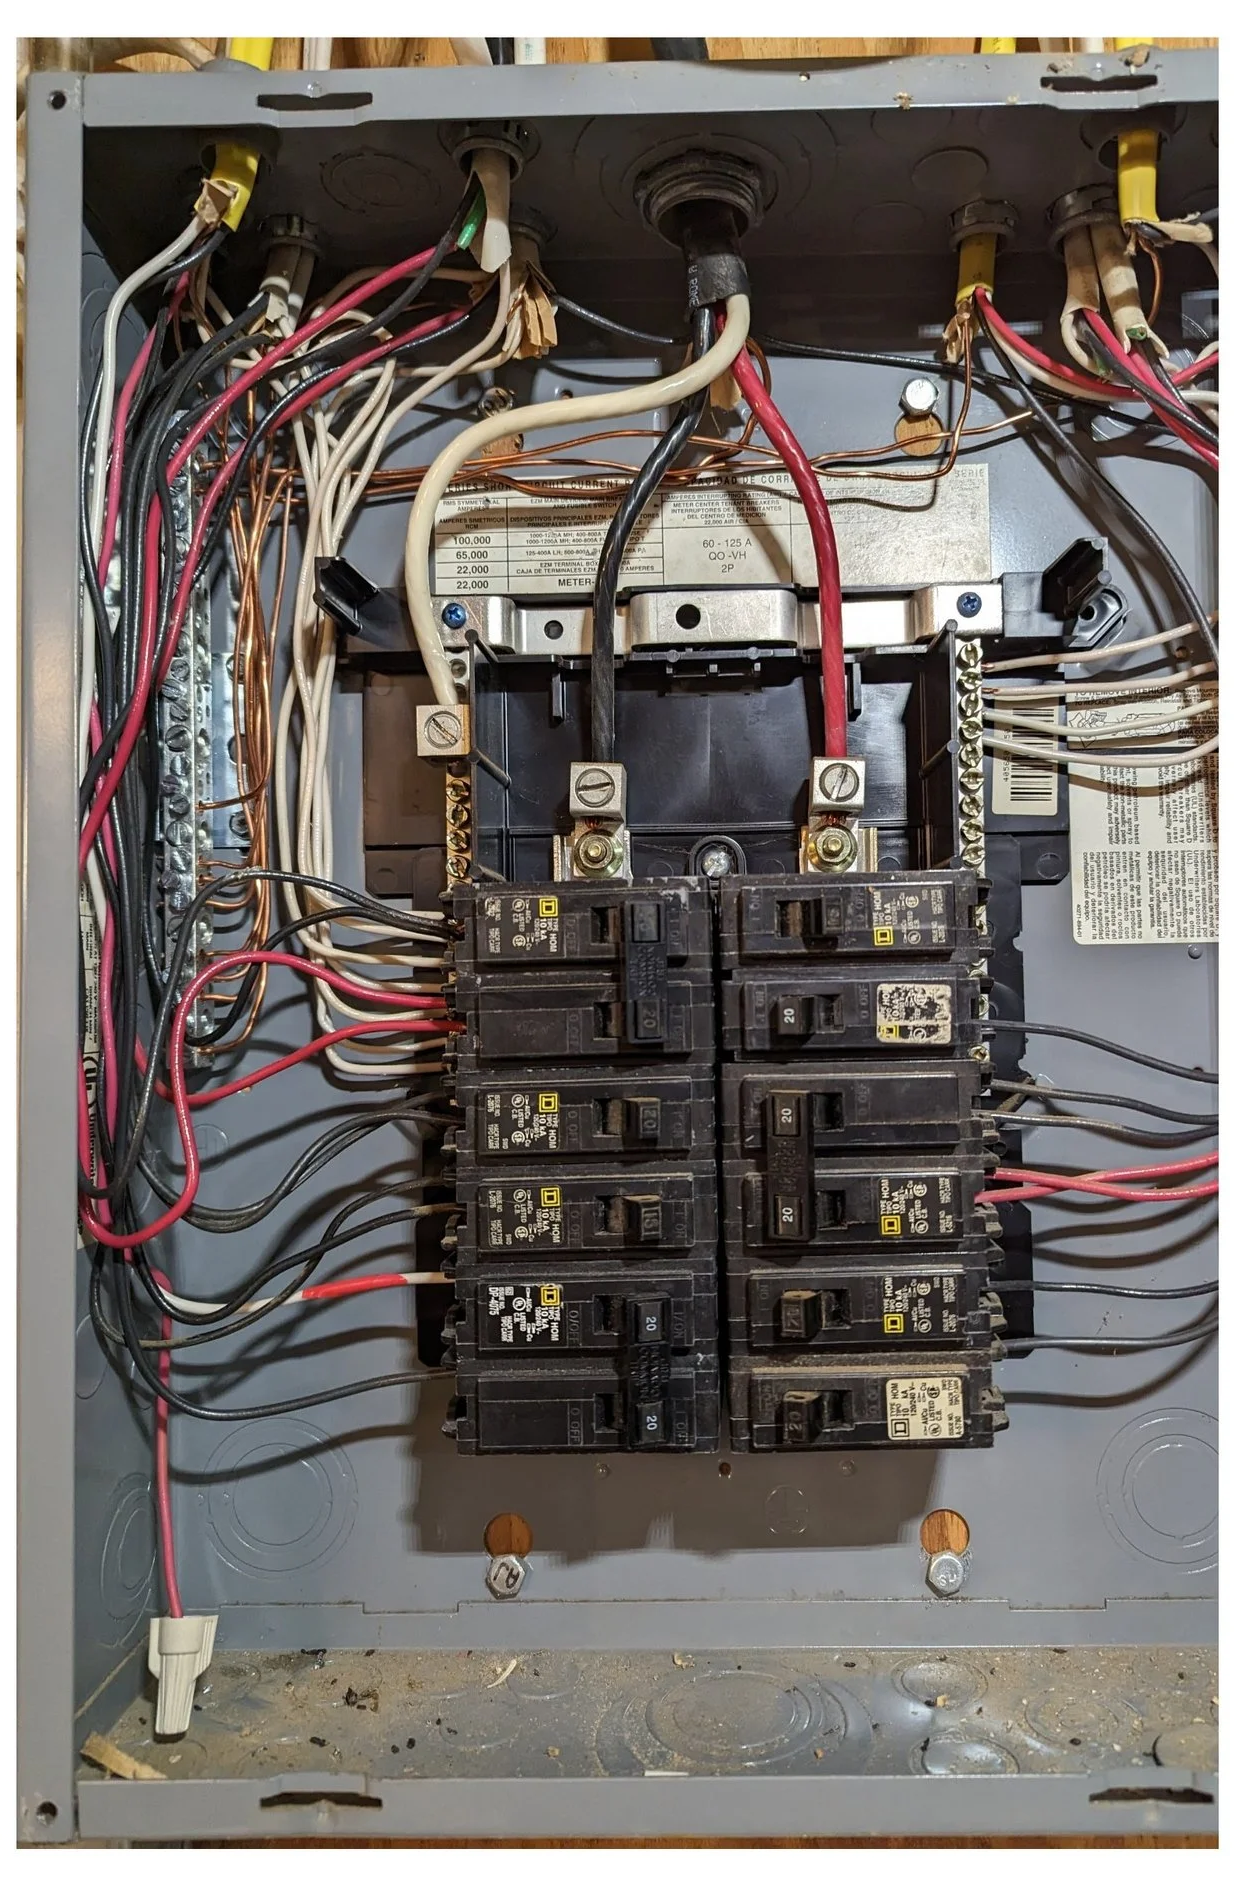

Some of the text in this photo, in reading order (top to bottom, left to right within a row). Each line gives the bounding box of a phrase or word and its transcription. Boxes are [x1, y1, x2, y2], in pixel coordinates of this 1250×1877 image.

[454, 536, 491, 545] 100,000
[703, 538, 752, 549] 60 125 A
[456, 551, 488, 561] 65,000
[708, 551, 747, 561] QO -VH
[456, 566, 489, 576] 22,000
[722, 564, 734, 573] 2P
[456, 580, 489, 590] 22,000
[643, 1010, 655, 1028] 20
[784, 1008, 794, 1023] 20
[644, 1110, 657, 1129] 20
[781, 1108, 792, 1123] 20
[539, 1114, 547, 1137] 10 kA
[549, 1129, 557, 1149] HOM
[542, 1208, 550, 1231] 10 kA
[782, 1207, 793, 1222] 20
[552, 1223, 560, 1243] HOM
[885, 1276, 893, 1297] HOM
[489, 1286, 499, 1316] DP-4075
[541, 1307, 549, 1330] 10 kA
[646, 1316, 657, 1331] 20
[551, 1322, 559, 1341] HOM
[891, 1383, 899, 1399] HOM
[901, 1390, 910, 1416] 10 kA
[646, 1415, 657, 1430] 20
